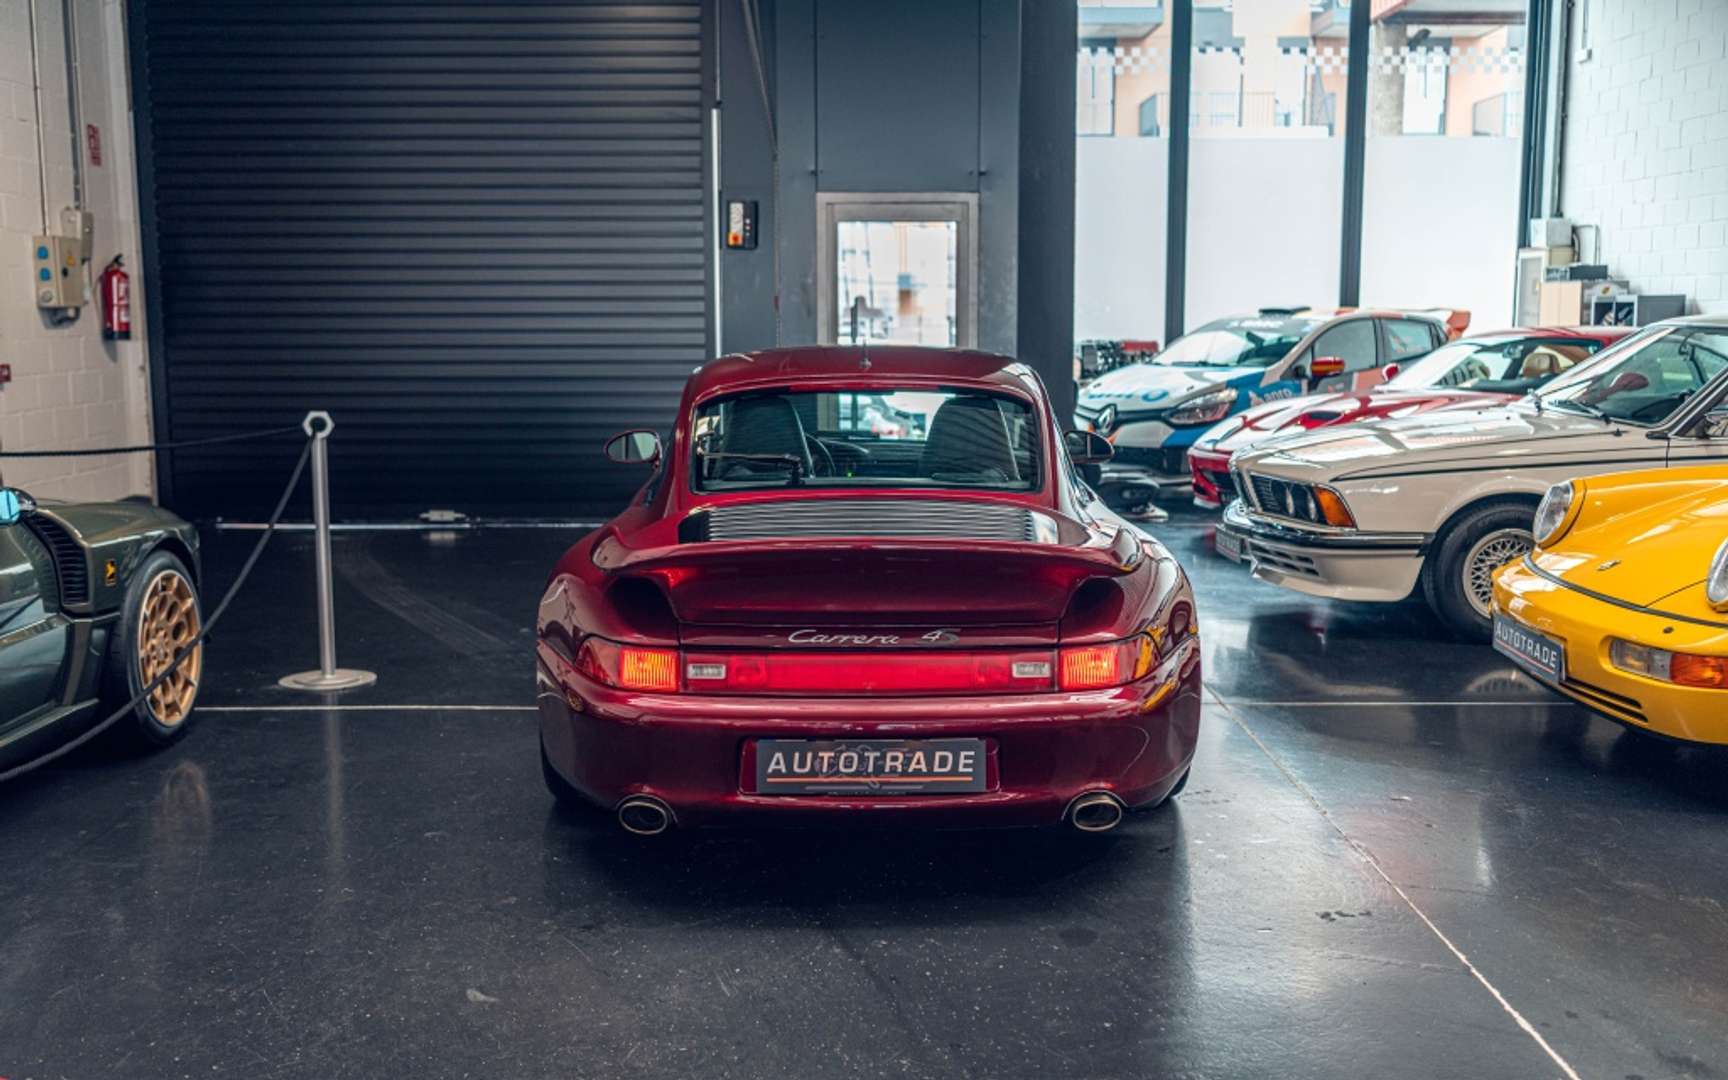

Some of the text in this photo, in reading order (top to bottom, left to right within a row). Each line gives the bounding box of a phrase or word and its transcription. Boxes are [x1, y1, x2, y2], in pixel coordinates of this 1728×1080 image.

[788, 628, 962, 645] Carrera 4S
[1495, 621, 1558, 669] AUTOTRADE
[766, 751, 976, 774] AUTOTRADE
